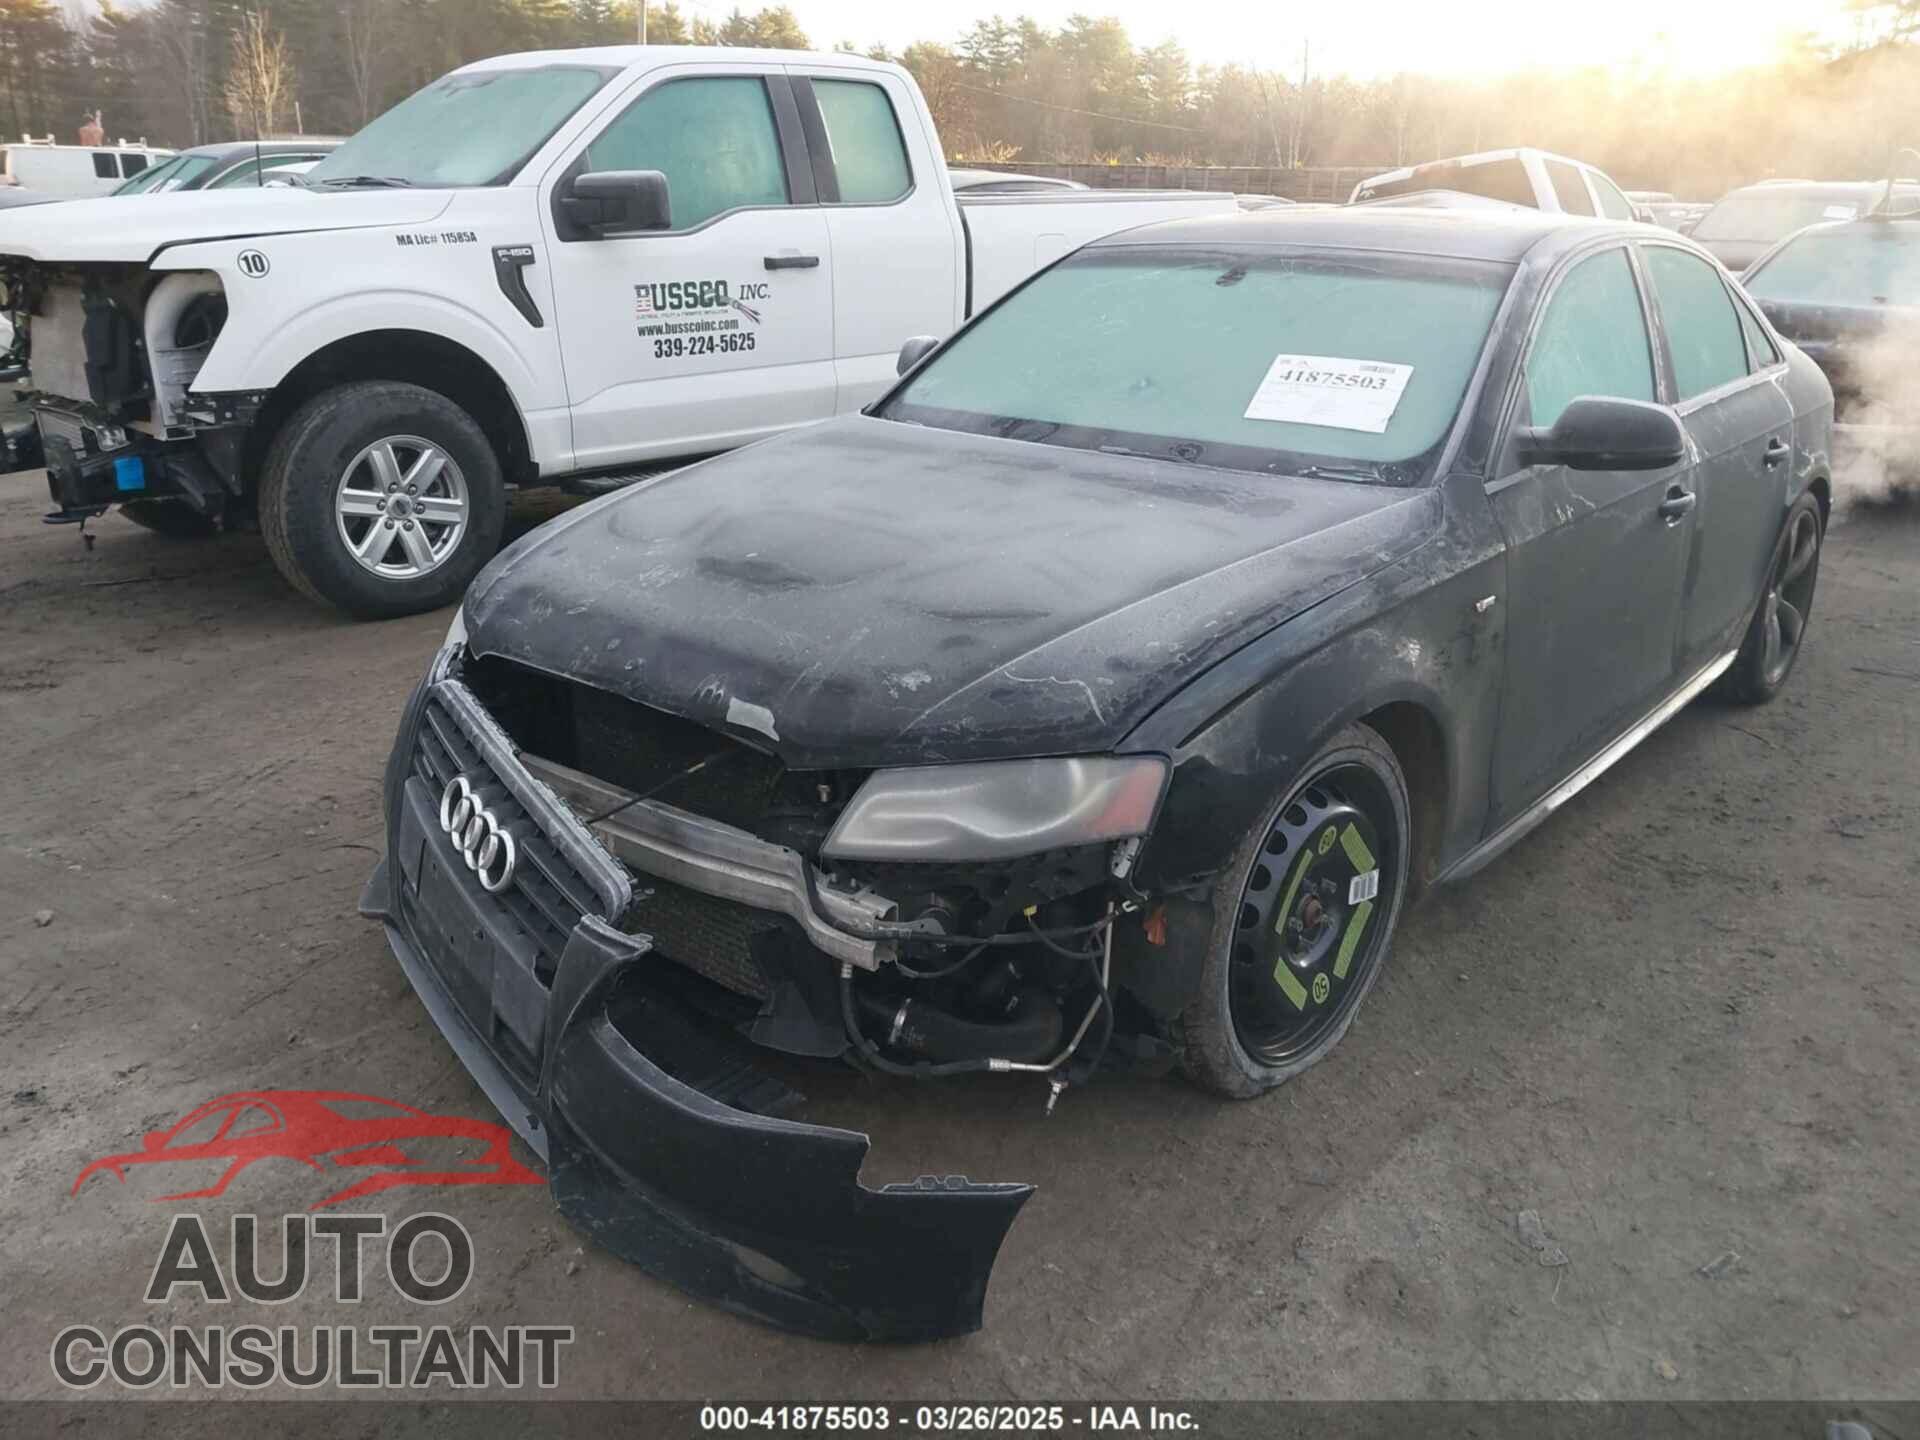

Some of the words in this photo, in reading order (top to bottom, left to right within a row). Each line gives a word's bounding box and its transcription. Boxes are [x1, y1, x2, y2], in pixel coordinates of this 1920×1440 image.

[240, 254, 265, 273] 10
[739, 284, 771, 301] INC.
[637, 319, 739, 337] www.busscoinc.com
[654, 332, 755, 358] 339-224-5625
[1280, 370, 1387, 390] 41875503
